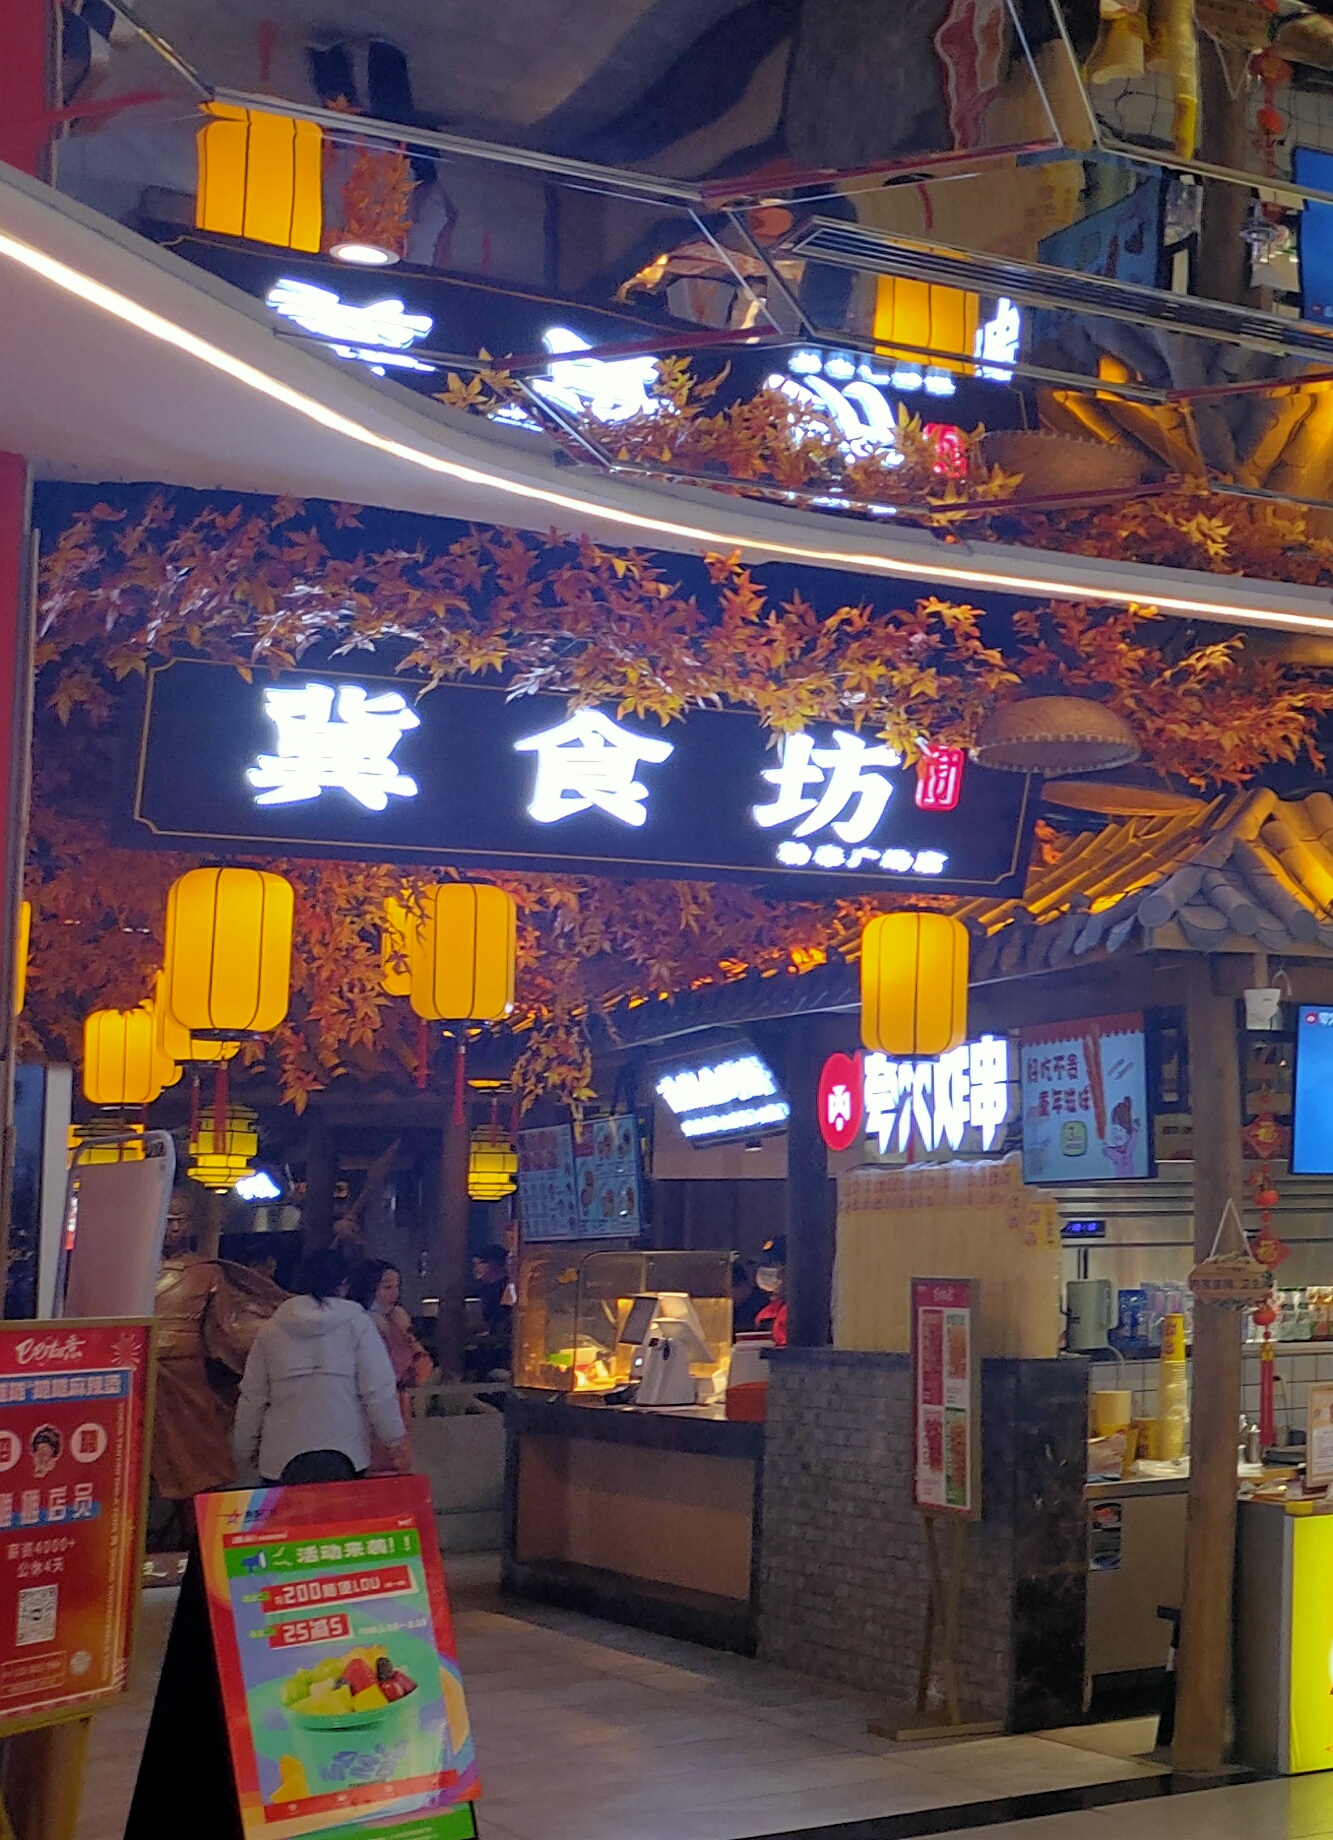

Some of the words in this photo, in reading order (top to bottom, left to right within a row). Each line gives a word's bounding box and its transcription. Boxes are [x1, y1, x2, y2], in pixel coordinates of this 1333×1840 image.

[246, 683, 901, 843] 冀食坊
[863, 1035, 1008, 1154] 夸父炸串
